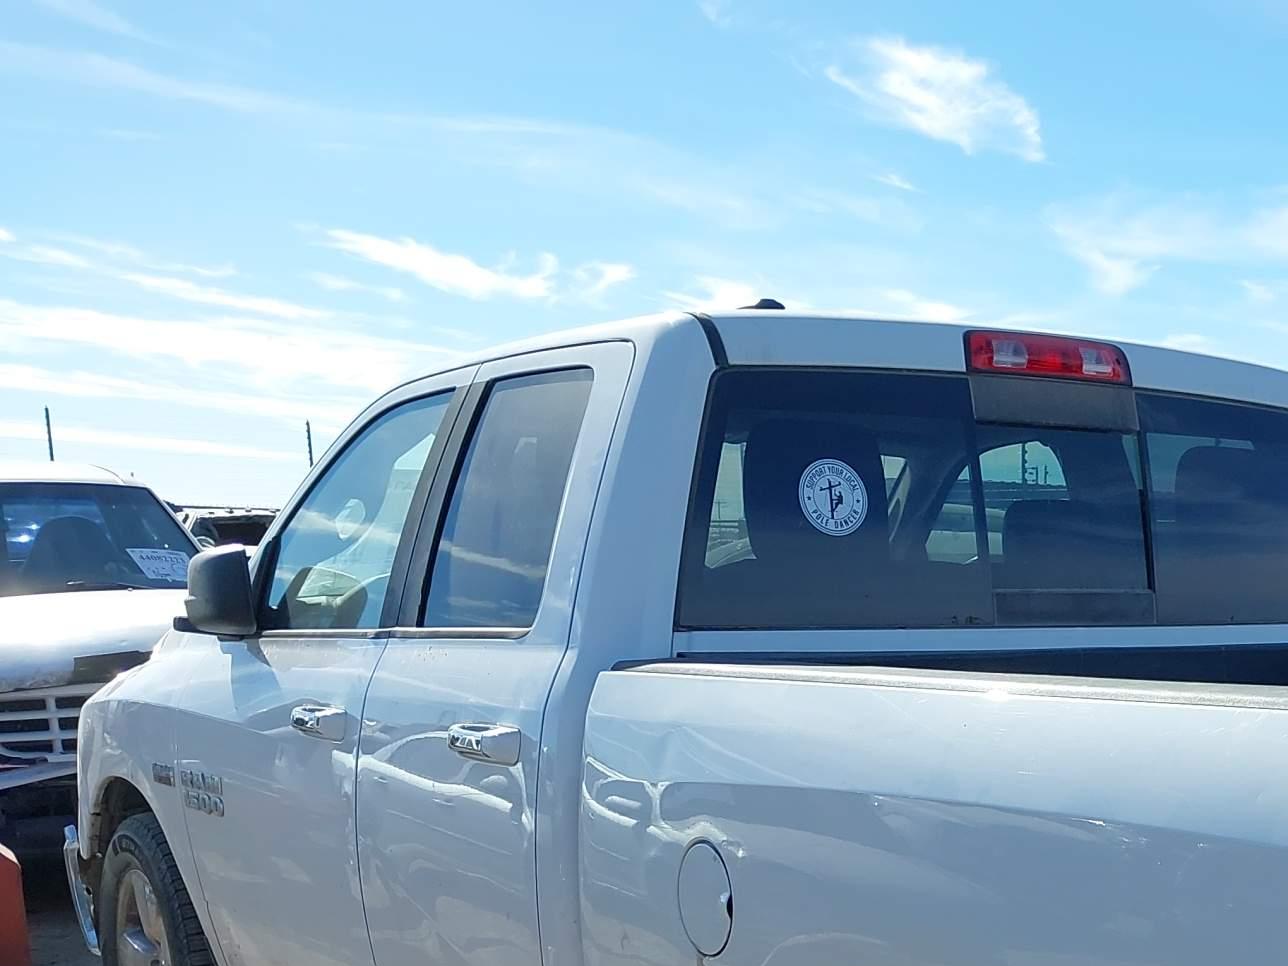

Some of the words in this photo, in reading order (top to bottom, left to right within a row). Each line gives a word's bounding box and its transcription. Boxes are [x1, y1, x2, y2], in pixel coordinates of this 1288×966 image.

[806, 466, 826, 489] SUPPORT
[827, 465, 844, 476] YOUR
[844, 472, 860, 490] LOCAL
[811, 509, 830, 527] POLE
[834, 509, 860, 528] DANCER
